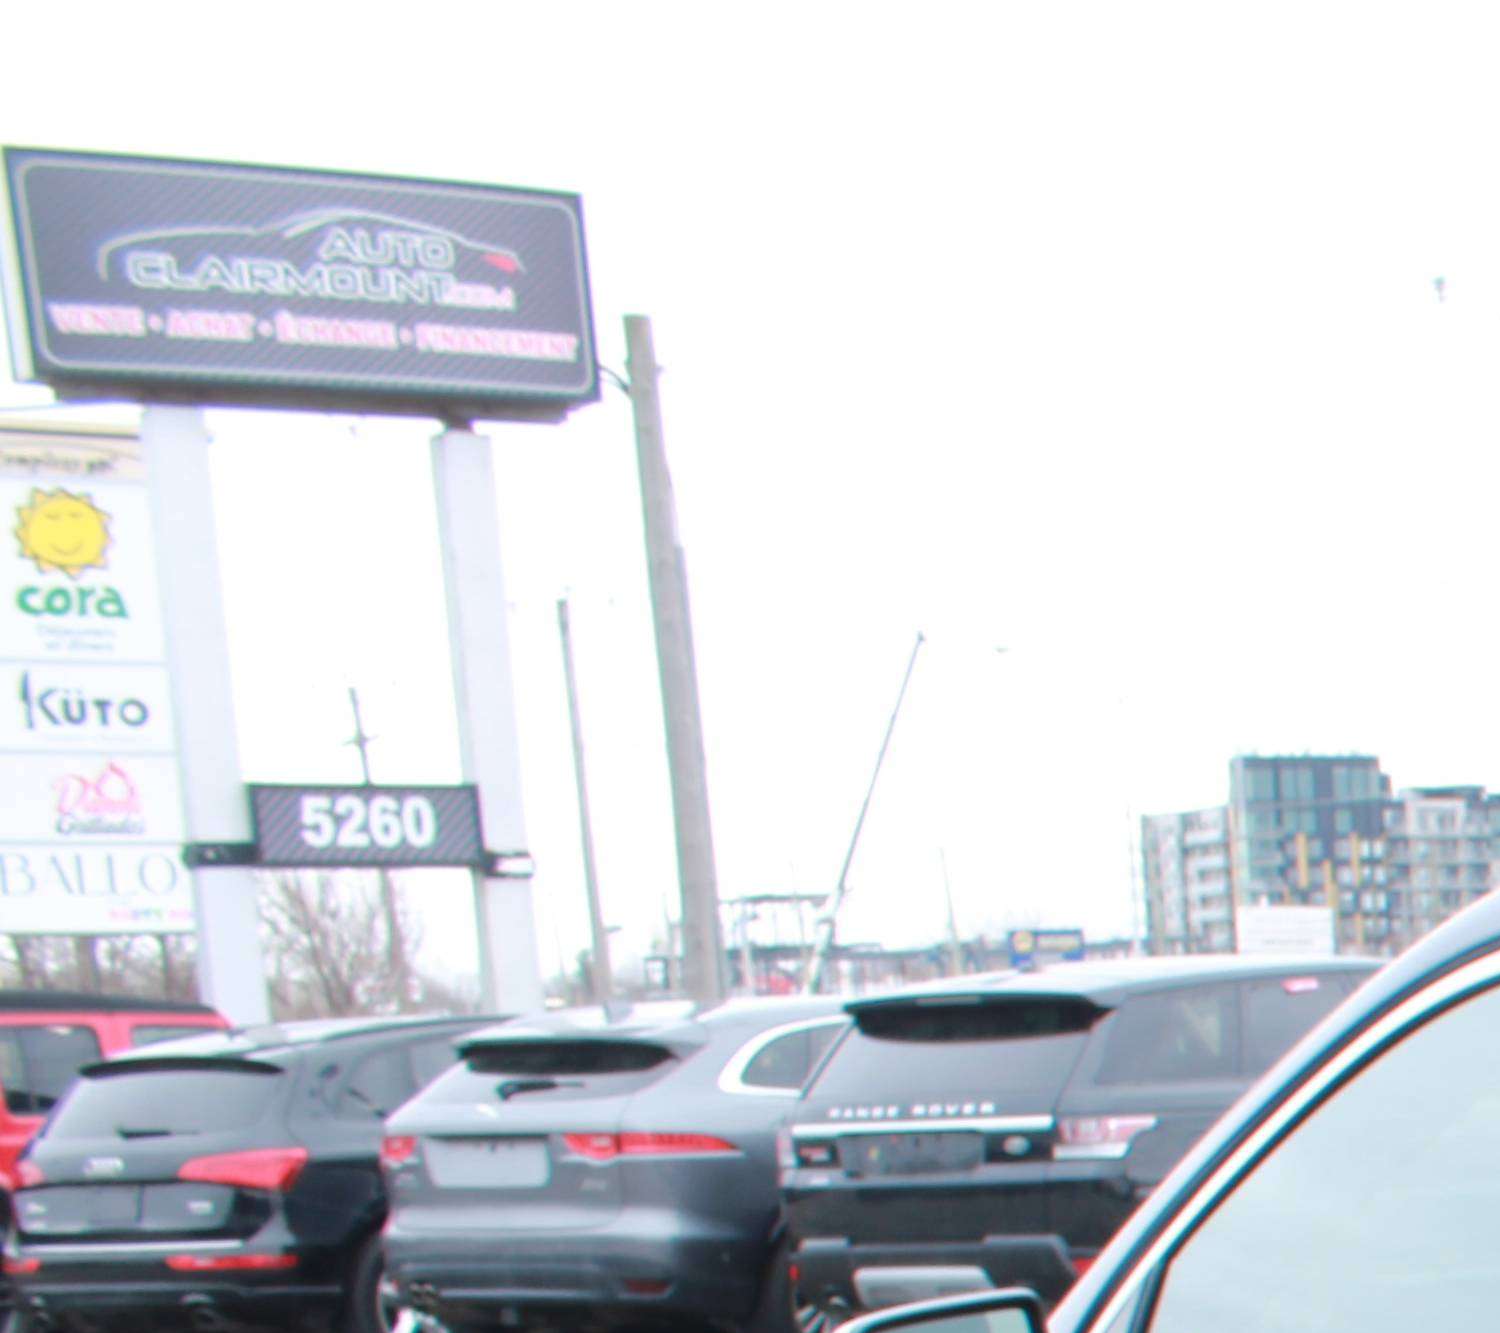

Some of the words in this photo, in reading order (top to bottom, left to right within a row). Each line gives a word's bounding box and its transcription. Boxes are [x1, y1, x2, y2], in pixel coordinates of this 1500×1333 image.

[319, 226, 455, 270] AUTO
[126, 250, 457, 304] CLAIRMOUNT
[15, 584, 130, 619] cora
[300, 793, 437, 850] 5260
[911, 1101, 996, 1116] ROVER
